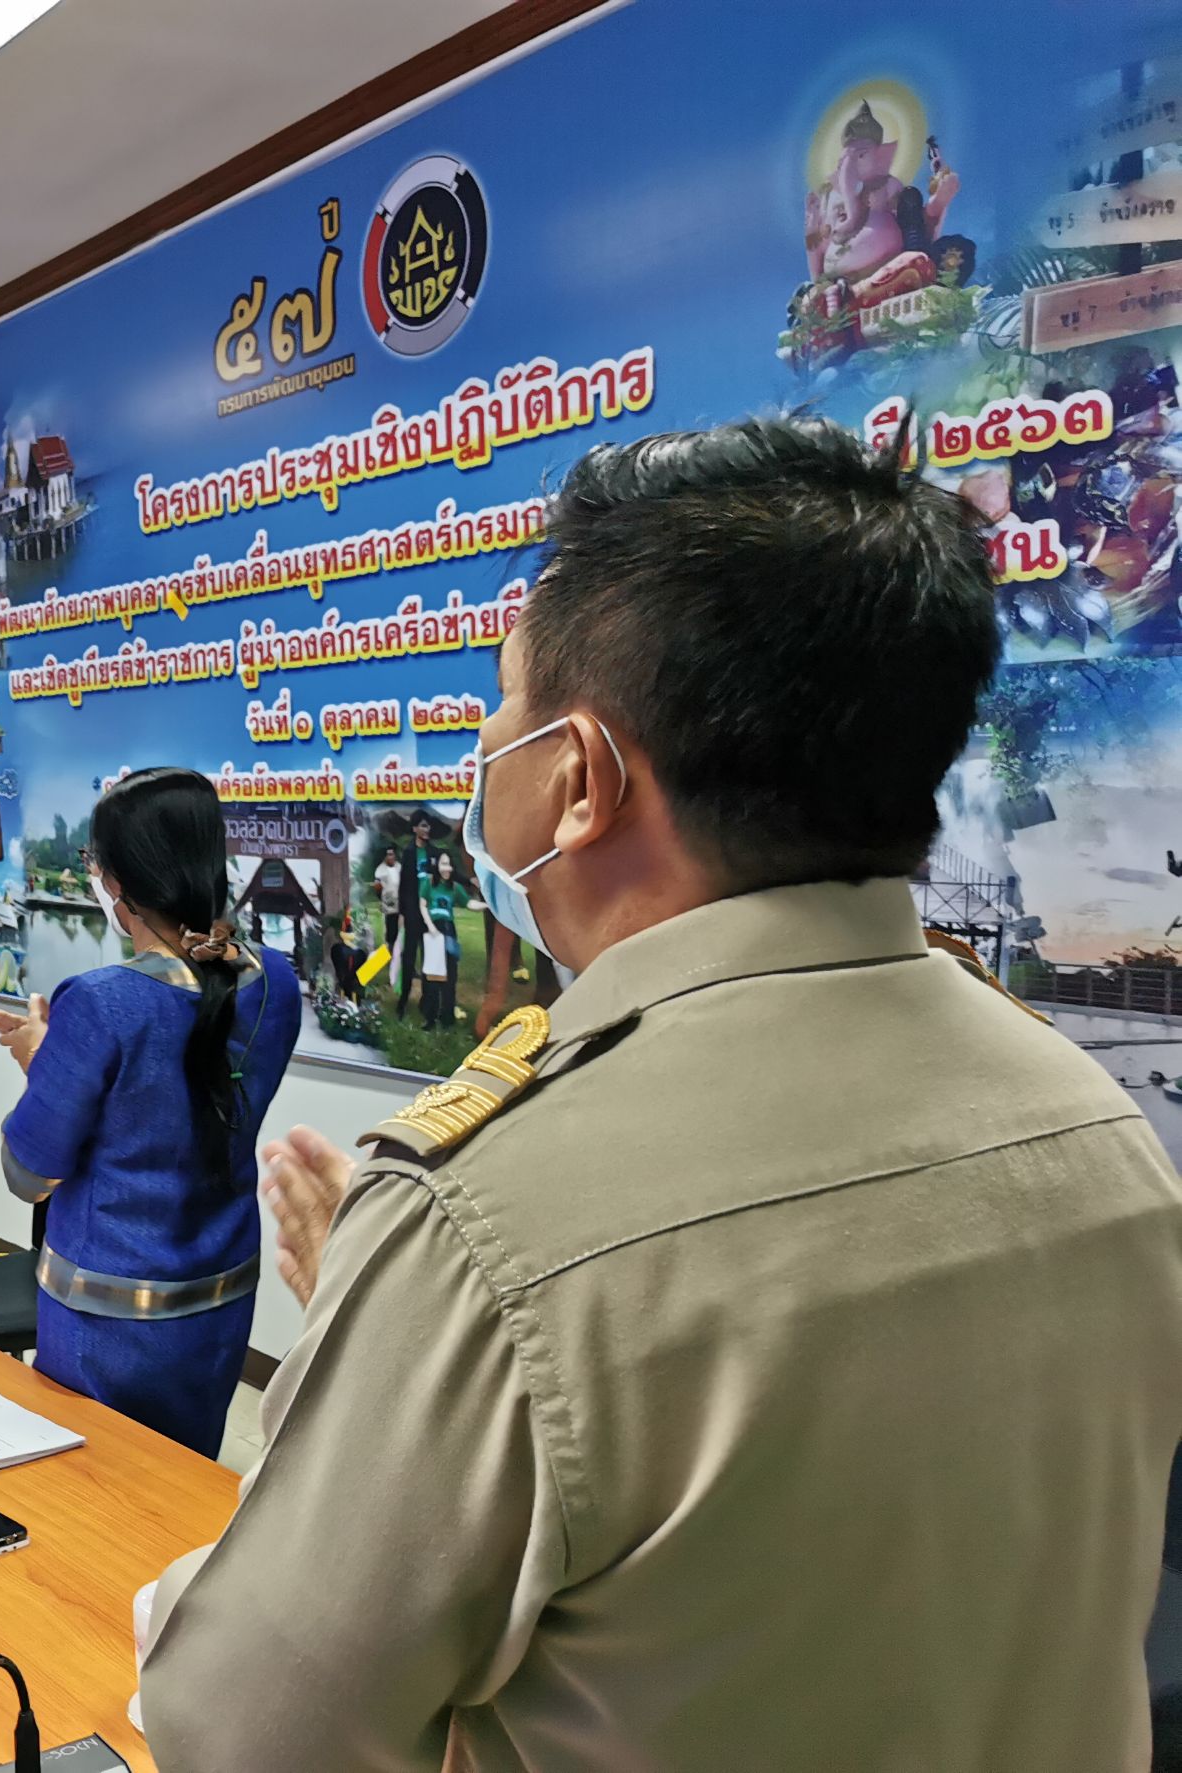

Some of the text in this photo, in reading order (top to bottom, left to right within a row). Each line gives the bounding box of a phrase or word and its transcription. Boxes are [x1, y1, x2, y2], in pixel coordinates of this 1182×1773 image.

[136, 352, 649, 531] โครงการประชุมเชิงปฏิบัติการ
[930, 399, 1104, 460] ๒๕๖๓
[249, 692, 289, 735] วันที่
[323, 704, 397, 746] ตุลาคม
[413, 701, 481, 727] ๒๕๖๒
[213, 764, 342, 797] ด์รอยัลพลาซ่า
